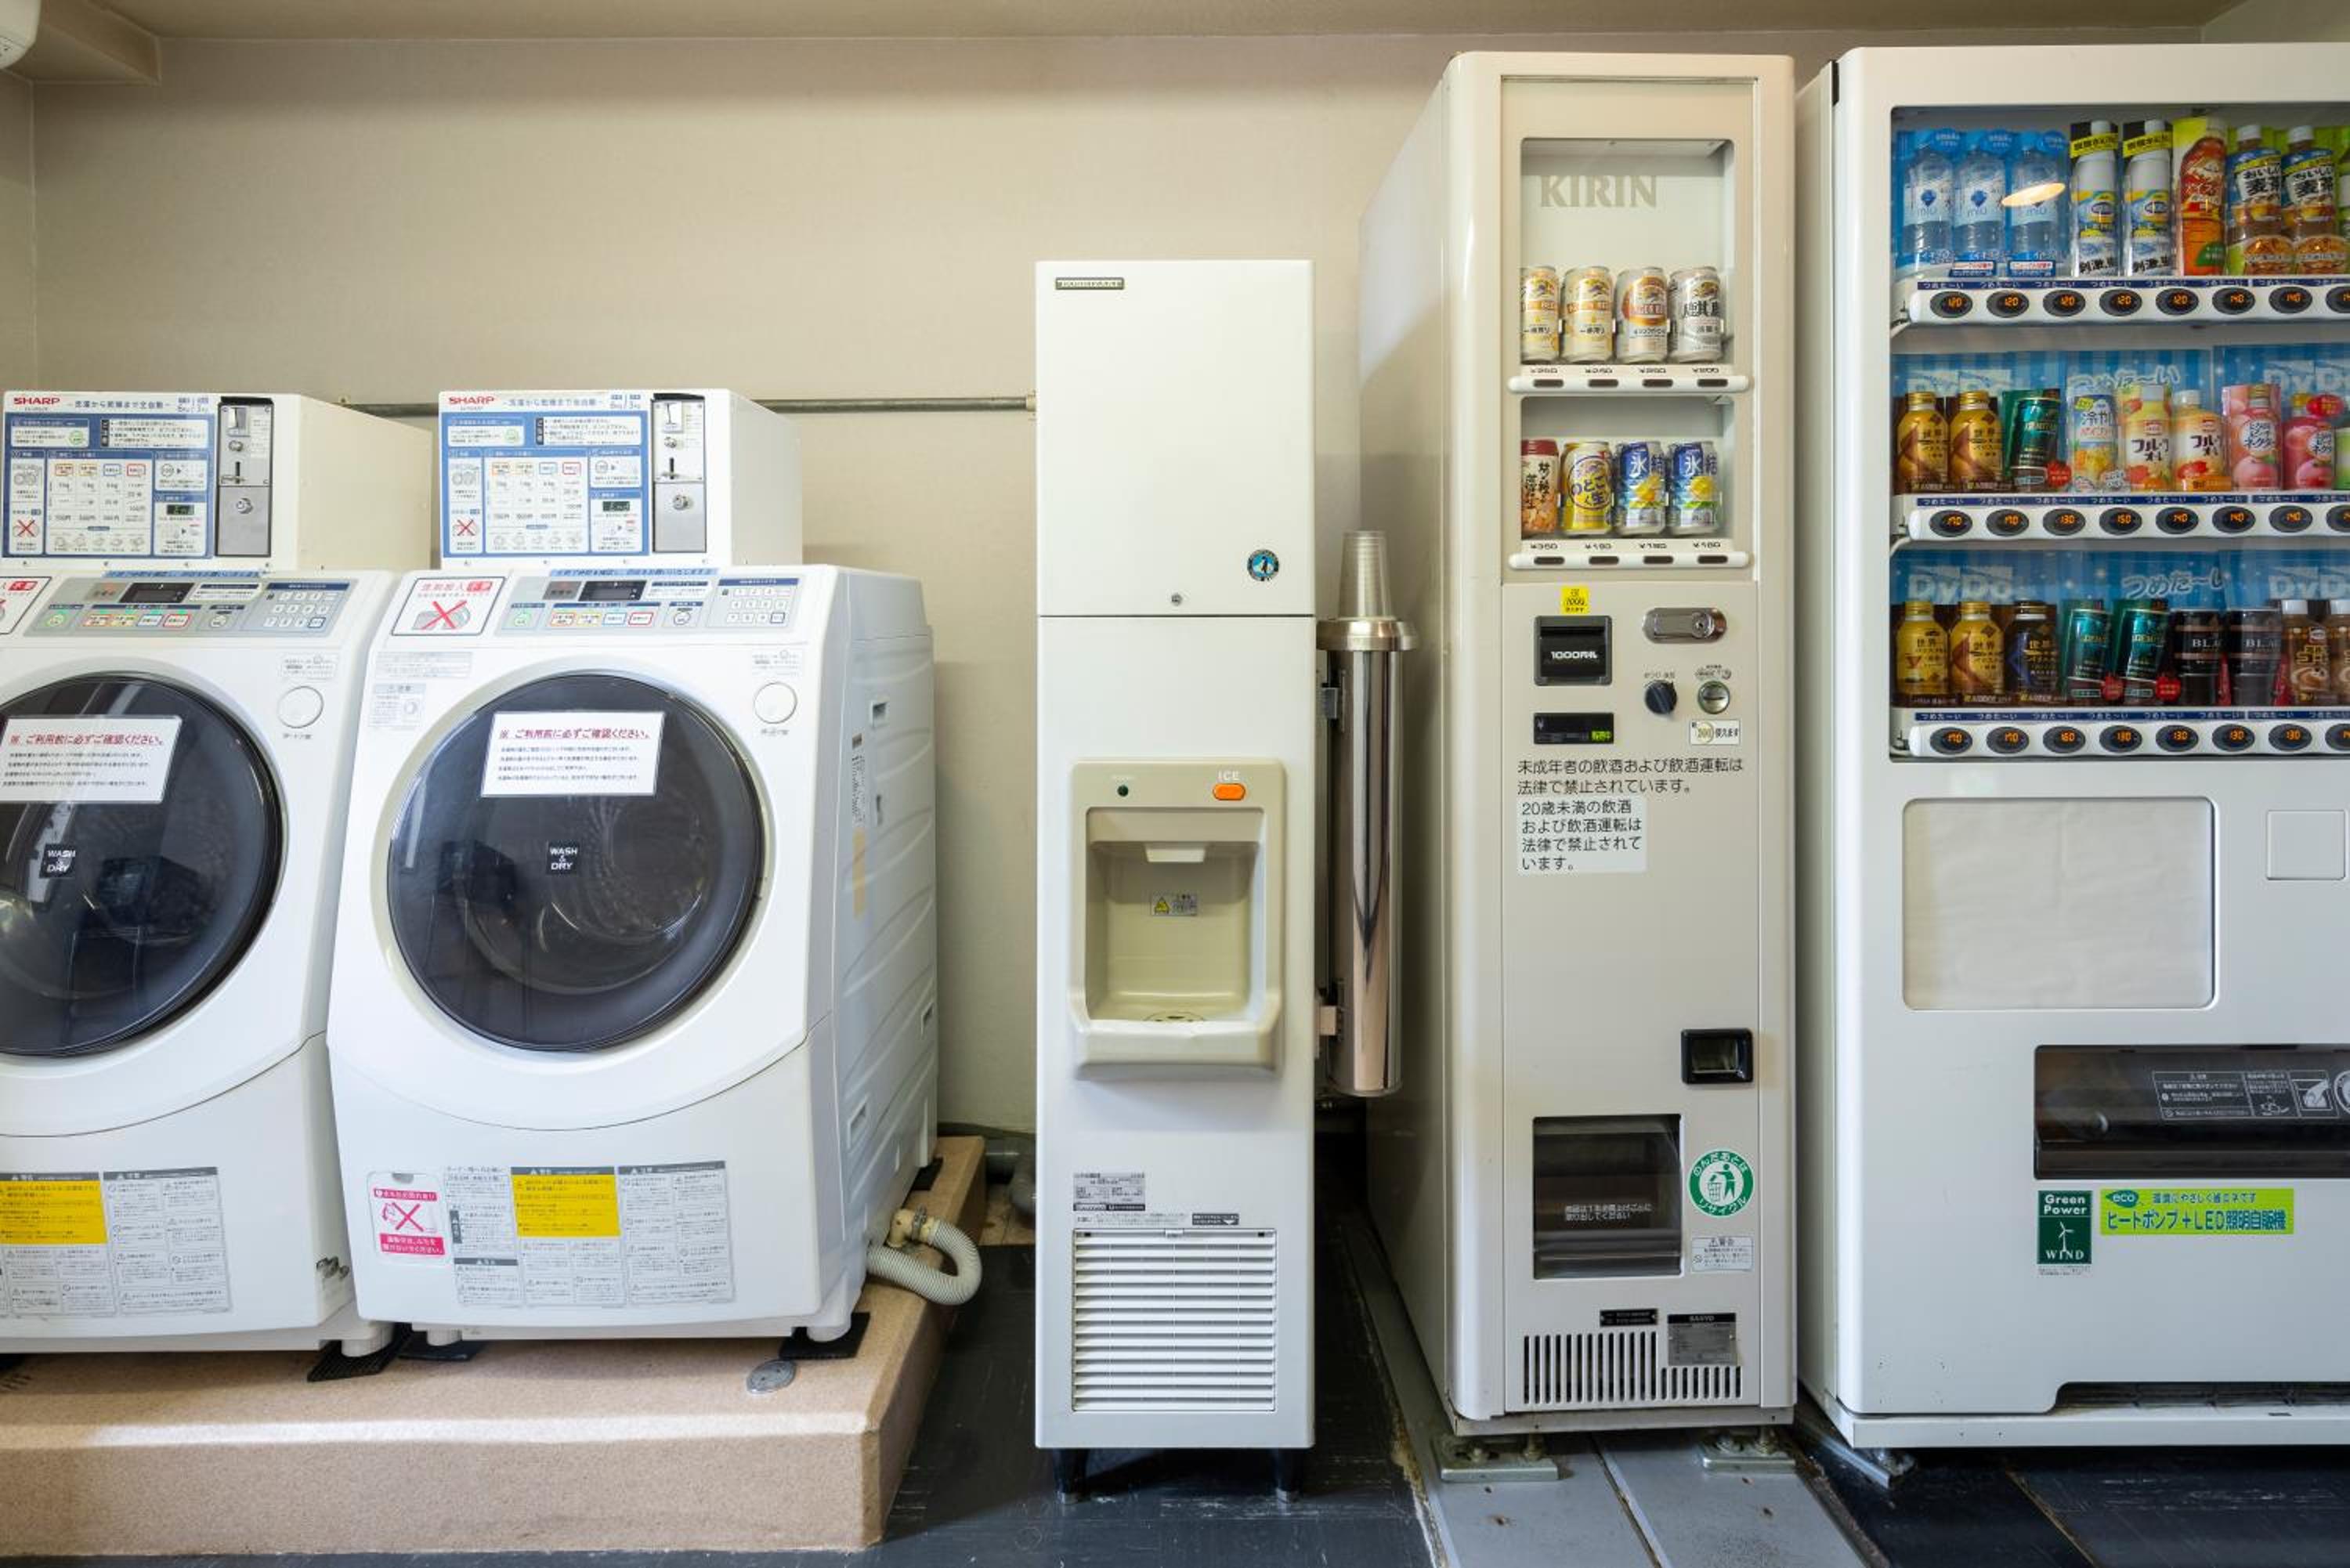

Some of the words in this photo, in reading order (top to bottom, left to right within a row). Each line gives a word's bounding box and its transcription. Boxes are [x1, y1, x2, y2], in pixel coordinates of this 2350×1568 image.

[1542, 175, 1657, 208] KIRIN
[2005, 296, 2019, 306] 120
[2117, 295, 2131, 305] 120
[2174, 294, 2188, 304] 120
[448, 396, 494, 405] SHARP
[2059, 515, 2075, 525] 130
[2117, 515, 2131, 524] 150
[2173, 514, 2188, 523] 140
[515, 728, 650, 739] ご利用前に必ずご確認ください。
[2174, 732, 2188, 740] 130
[2230, 731, 2244, 740] 130
[2287, 730, 2301, 740] 130
[27, 734, 163, 746] ご利用前に必ずご確認ください。
[1517, 757, 1744, 775] 未成年者の飲酒および飲酒運転は
[1217, 771, 1240, 781] ICE
[1517, 779, 1690, 795] 法律で禁止されています。
[1522, 799, 1632, 815] 20歳未満の飲酒
[1522, 818, 1643, 833] および飲酒運転は
[1522, 836, 1642, 853] 法律で禁止されて
[47, 865, 70, 873] DRY
[551, 862, 573, 871] DRY
[1522, 856, 1574, 872] います。
[1693, 1151, 1749, 1178] のんだあとは
[2044, 1194, 2086, 1205] Green
[2112, 1193, 2135, 1203] eco
[2153, 1193, 2256, 1205] 環境にやさしく省エネです
[1699, 1195, 1747, 1216] リサイクル
[2043, 1205, 2087, 1215] Power
[2045, 1249, 2084, 1260] WIND
